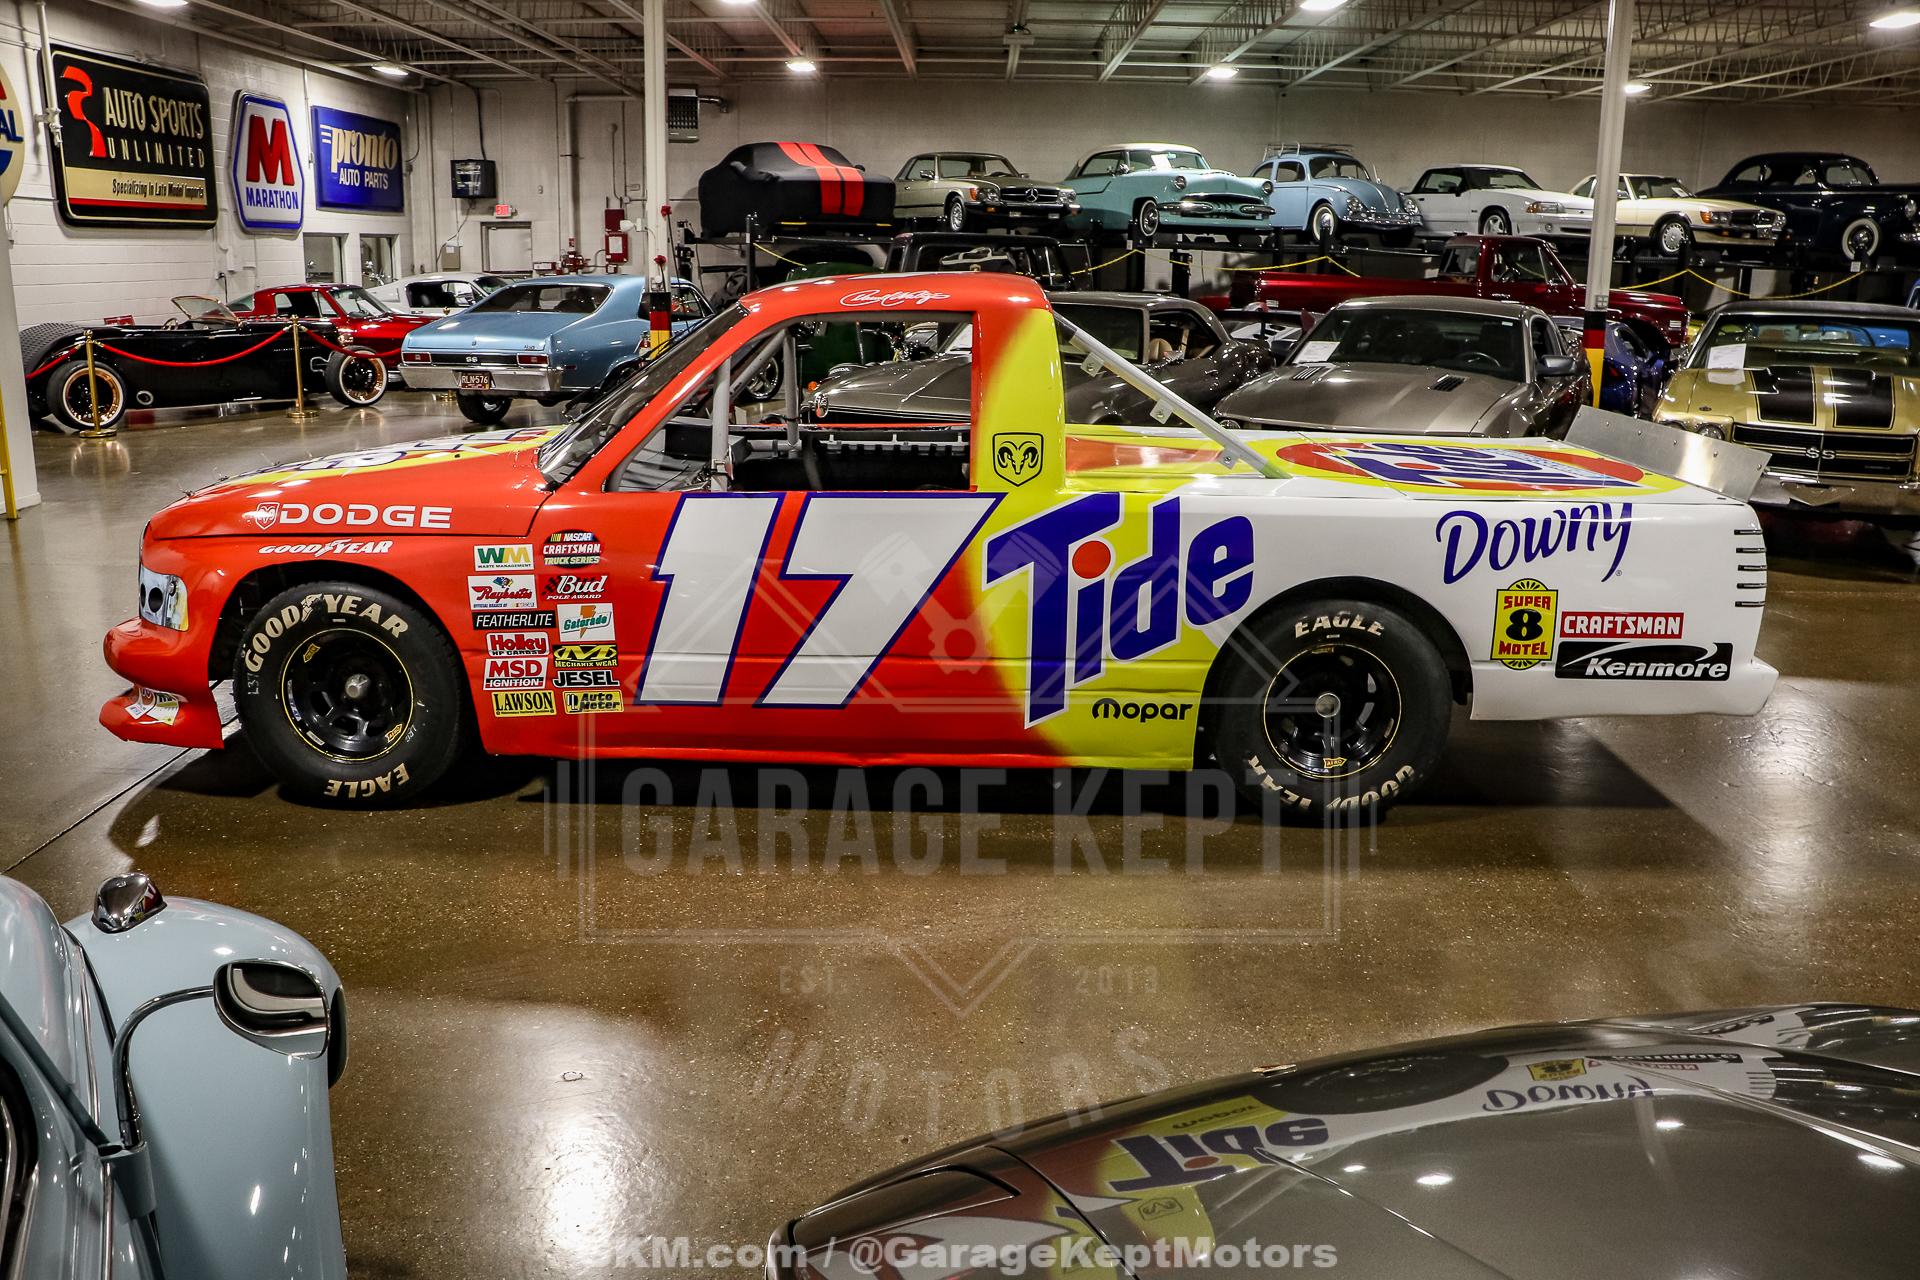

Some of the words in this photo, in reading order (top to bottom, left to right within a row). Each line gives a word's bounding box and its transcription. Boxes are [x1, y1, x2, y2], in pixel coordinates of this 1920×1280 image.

[103, 86, 146, 131] AUTO
[148, 95, 205, 140] SPORTS
[107, 137, 205, 169] UNLIMITED
[246, 113, 296, 187] M
[331, 127, 398, 173] pronto
[112, 178, 148, 197] Specializing
[155, 183, 167, 198] Late
[168, 182, 183, 199] Model
[339, 167, 361, 187] AUTO
[364, 170, 389, 190] PARTS
[246, 186, 300, 210] MARATHON
[1805, 446, 1837, 460] SS
[279, 503, 453, 529] DODGE
[563, 532, 593, 542] NASCAR
[1435, 501, 1633, 585] Downy
[258, 538, 394, 558] GOODYEAR
[477, 546, 531, 564] WM
[542, 543, 601, 555] CRAFTSMAN
[544, 556, 570, 566] TRUCK
[570, 555, 601, 565] SERIES
[555, 575, 608, 594] Bud
[546, 593, 570, 601] POLE
[634, 491, 1009, 710] 17
[1503, 595, 1551, 610] SUPER
[984, 491, 1256, 726] Tide
[476, 613, 553, 628] FEATHERLITE
[563, 613, 608, 631] Gatorade
[1505, 608, 1544, 641] 8
[1563, 615, 1682, 635] CRAFTSMAN
[489, 633, 547, 654] Holley
[1498, 640, 1549, 656] MOTEL
[489, 660, 543, 678] MSD
[1585, 656, 1729, 679] Kenmore
[489, 678, 539, 687] IGNITION
[553, 670, 620, 687] JESEL
[493, 691, 553, 711] LAWSON
[580, 692, 613, 702] Auto
[580, 700, 621, 710] Meter
[323, 762, 410, 799] EAGLE
